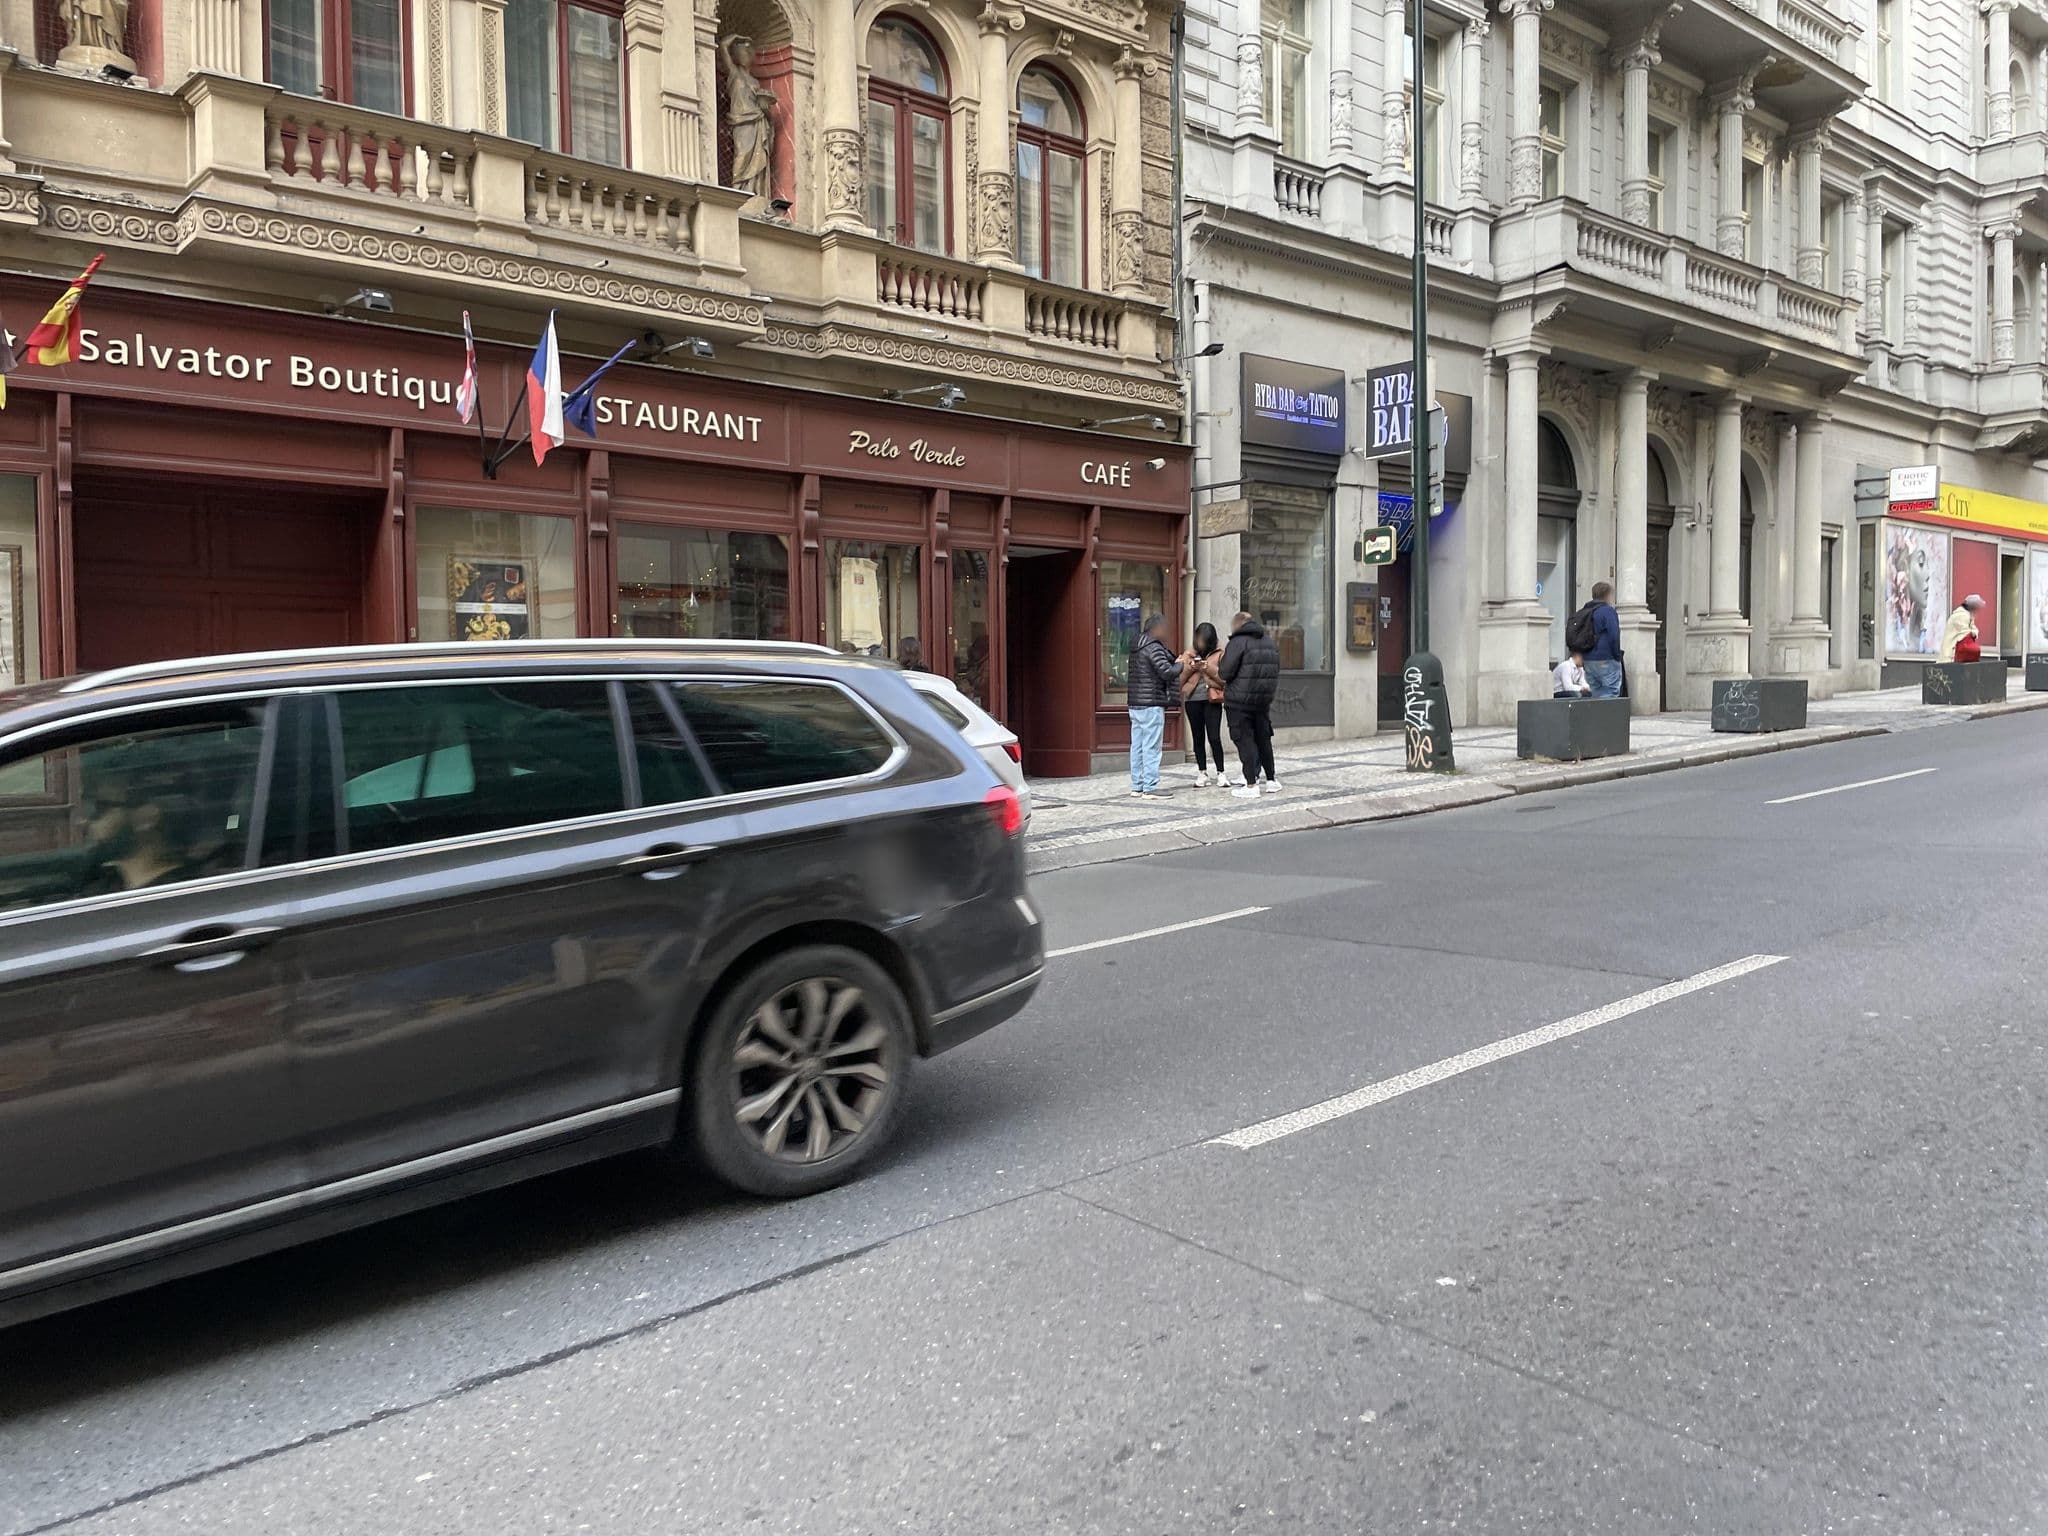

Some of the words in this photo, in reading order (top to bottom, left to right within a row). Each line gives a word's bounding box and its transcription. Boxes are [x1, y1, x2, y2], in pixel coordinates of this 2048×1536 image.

[79, 329, 272, 382] Salvator
[561, 391, 762, 442] STAURANT
[1254, 382, 1277, 410] RYBA
[1278, 386, 1295, 413] BAR
[1308, 392, 1339, 420] TATTOO
[849, 430, 900, 459] Palo
[909, 438, 966, 468] Verde
[1080, 461, 1131, 488] CAFÉ
